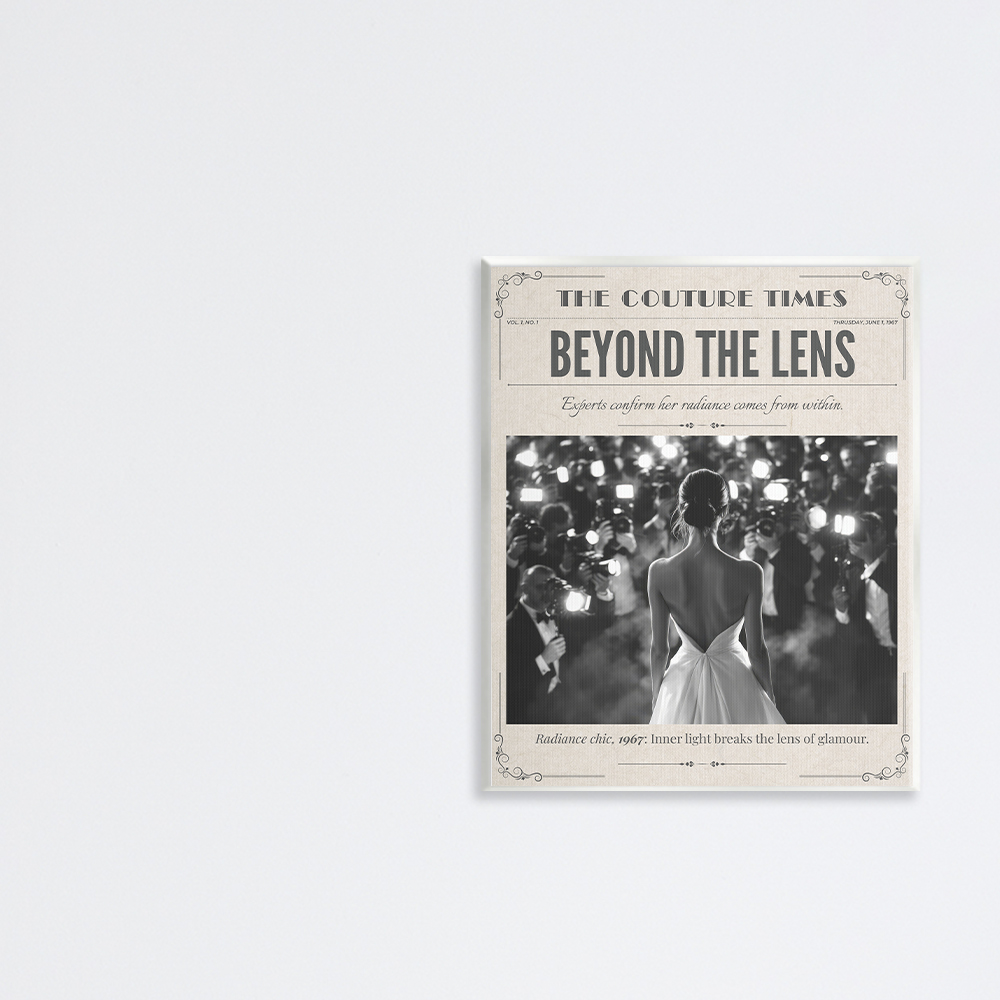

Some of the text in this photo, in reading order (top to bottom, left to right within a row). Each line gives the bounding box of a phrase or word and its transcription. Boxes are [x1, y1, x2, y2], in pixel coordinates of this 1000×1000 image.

[556, 289, 848, 308] THE COUTURE TIMES
[550, 329, 856, 378] BEYOND THE LENS
[561, 394, 844, 418] Experts confirm her radiance comes from within.
[535, 733, 588, 745] Radiance
[617, 734, 648, 746] 1967:
[650, 733, 683, 745] Inner
[684, 732, 712, 747] light
[713, 733, 753, 745] breaks
[755, 733, 775, 745] the
[776, 733, 801, 745] lens
[802, 733, 816, 745] of
[817, 733, 870, 747] glamour.
